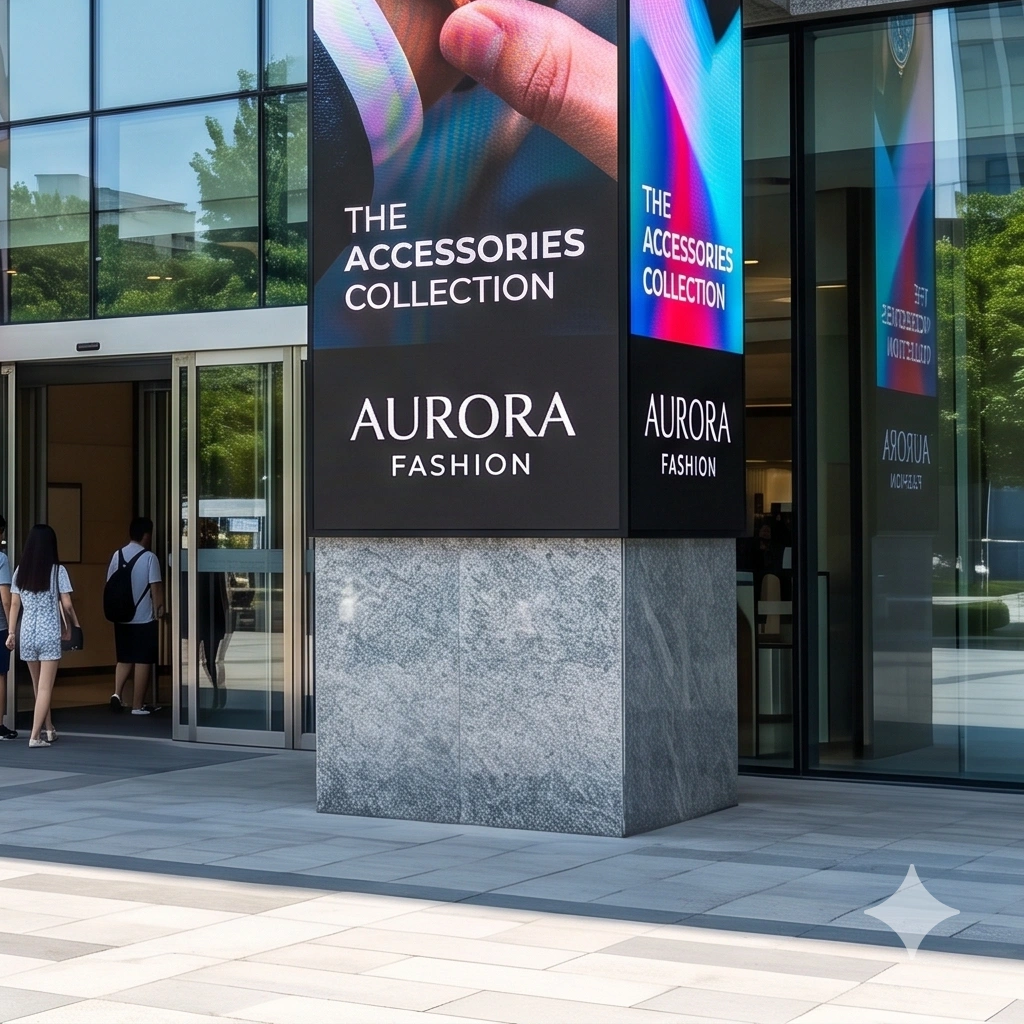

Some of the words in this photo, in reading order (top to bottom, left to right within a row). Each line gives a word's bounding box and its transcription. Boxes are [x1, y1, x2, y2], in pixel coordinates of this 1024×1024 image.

[344, 202, 407, 233] THE
[642, 184, 672, 219] THE
[344, 228, 585, 272] ACCESSORIES
[643, 226, 734, 274] ACCESSORIES
[344, 272, 554, 311] COLLECTION
[643, 267, 726, 311] COLLECTION
[350, 391, 576, 442] AURORA
[644, 392, 731, 444] AURORA
[392, 452, 531, 477] FASHION
[661, 453, 716, 478] FASHION
